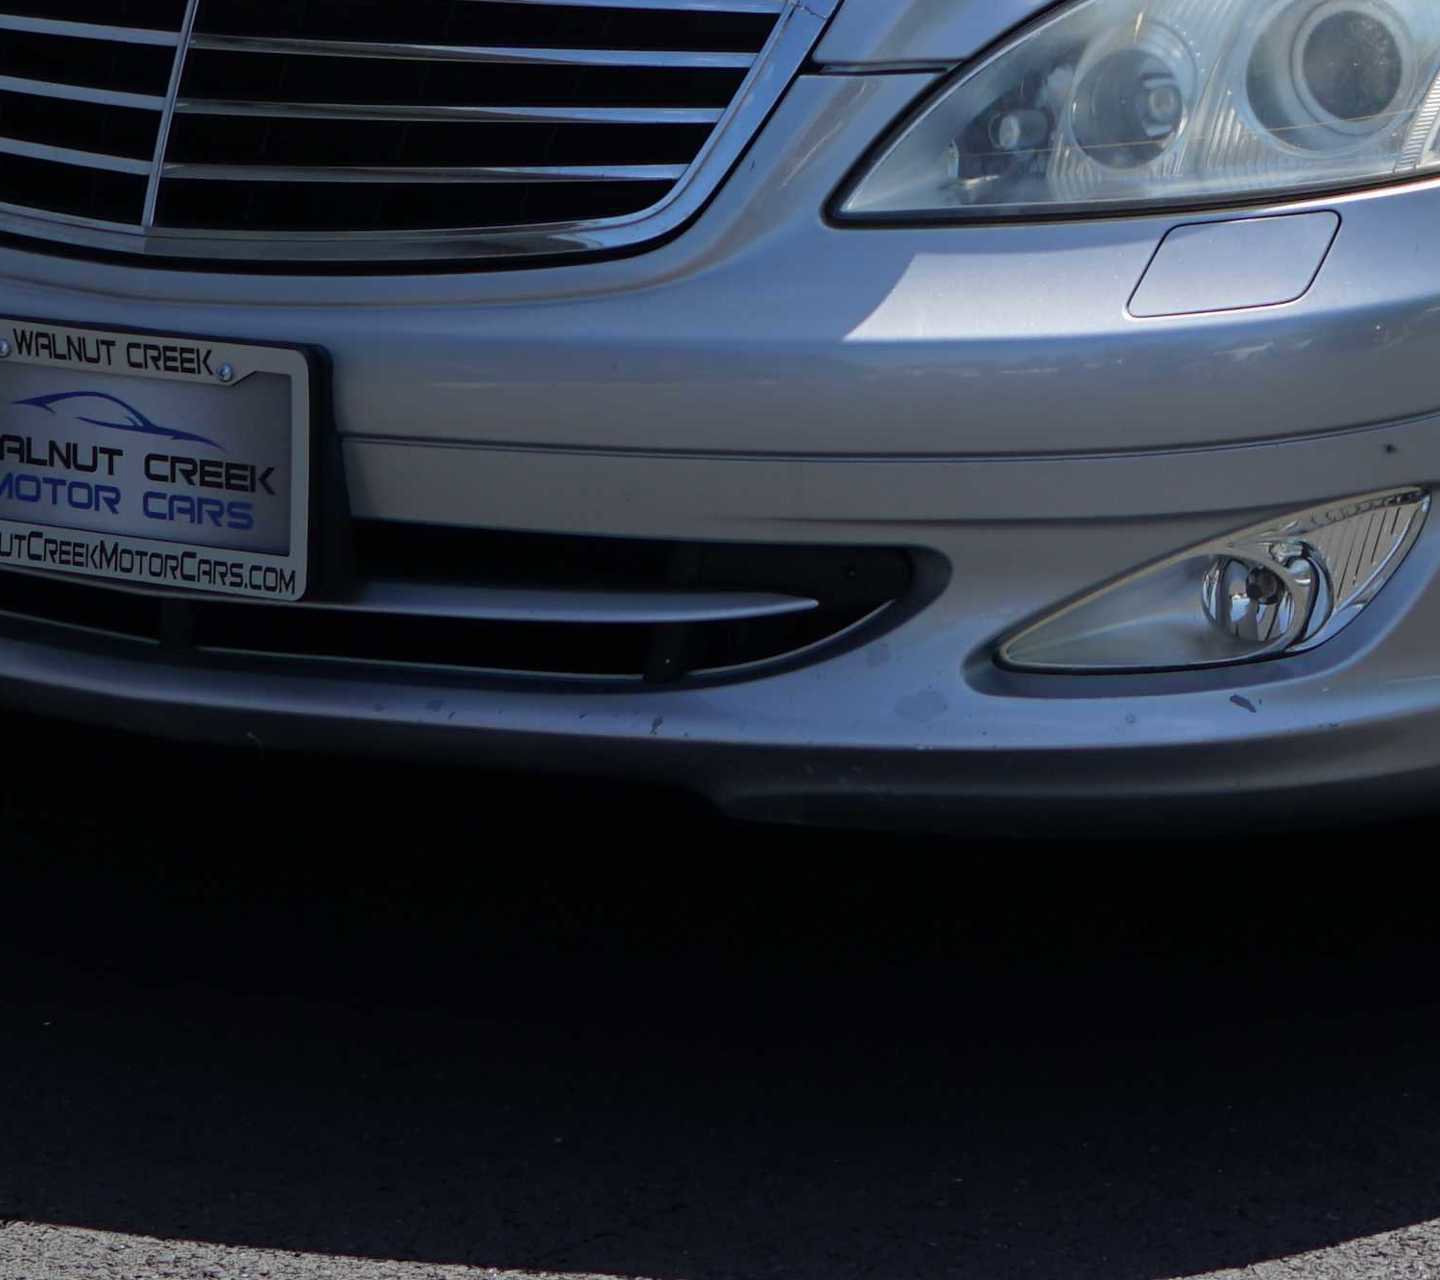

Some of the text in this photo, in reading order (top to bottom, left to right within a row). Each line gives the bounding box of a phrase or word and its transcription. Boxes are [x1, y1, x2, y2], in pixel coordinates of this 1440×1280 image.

[13, 328, 213, 376] WALNUT CREEK
[144, 453, 276, 495] CREEK
[143, 491, 255, 531] CARS
